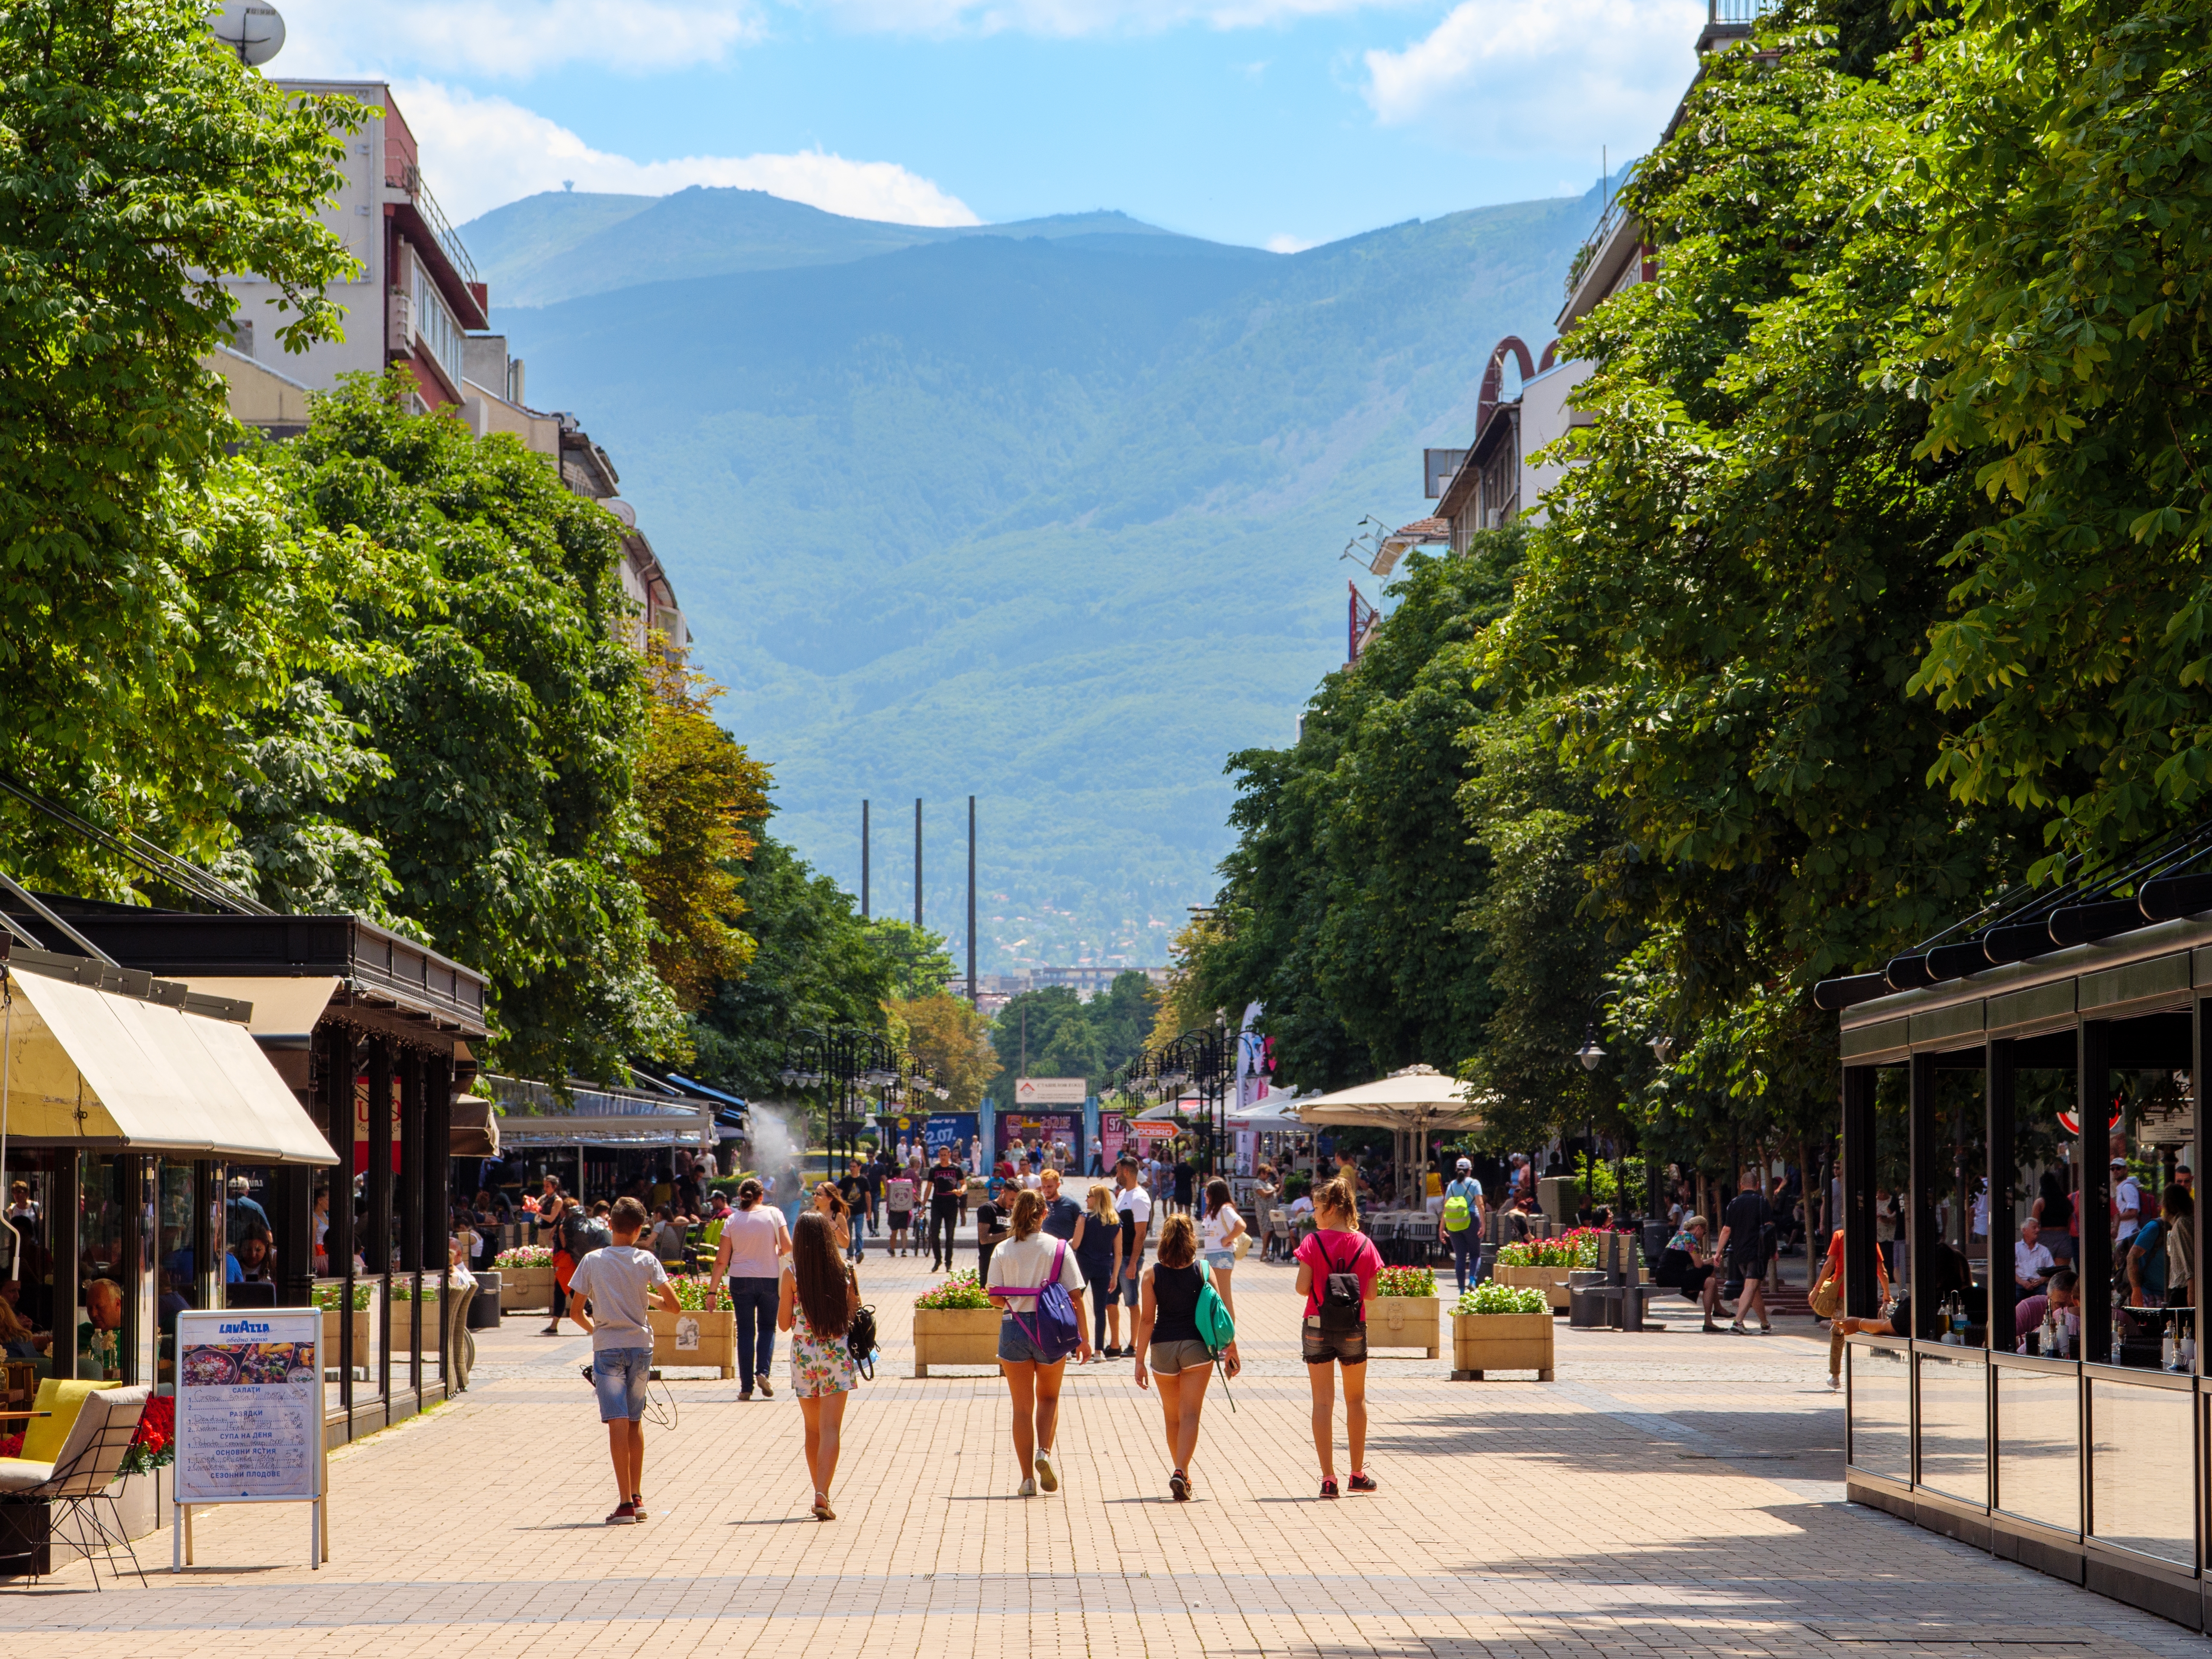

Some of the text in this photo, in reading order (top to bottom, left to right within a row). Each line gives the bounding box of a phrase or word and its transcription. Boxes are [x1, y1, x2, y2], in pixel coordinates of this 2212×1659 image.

[357, 1100, 401, 1122] UO
[219, 1320, 270, 1333] LAVAZZA
[192, 1437, 218, 1446] Potato
